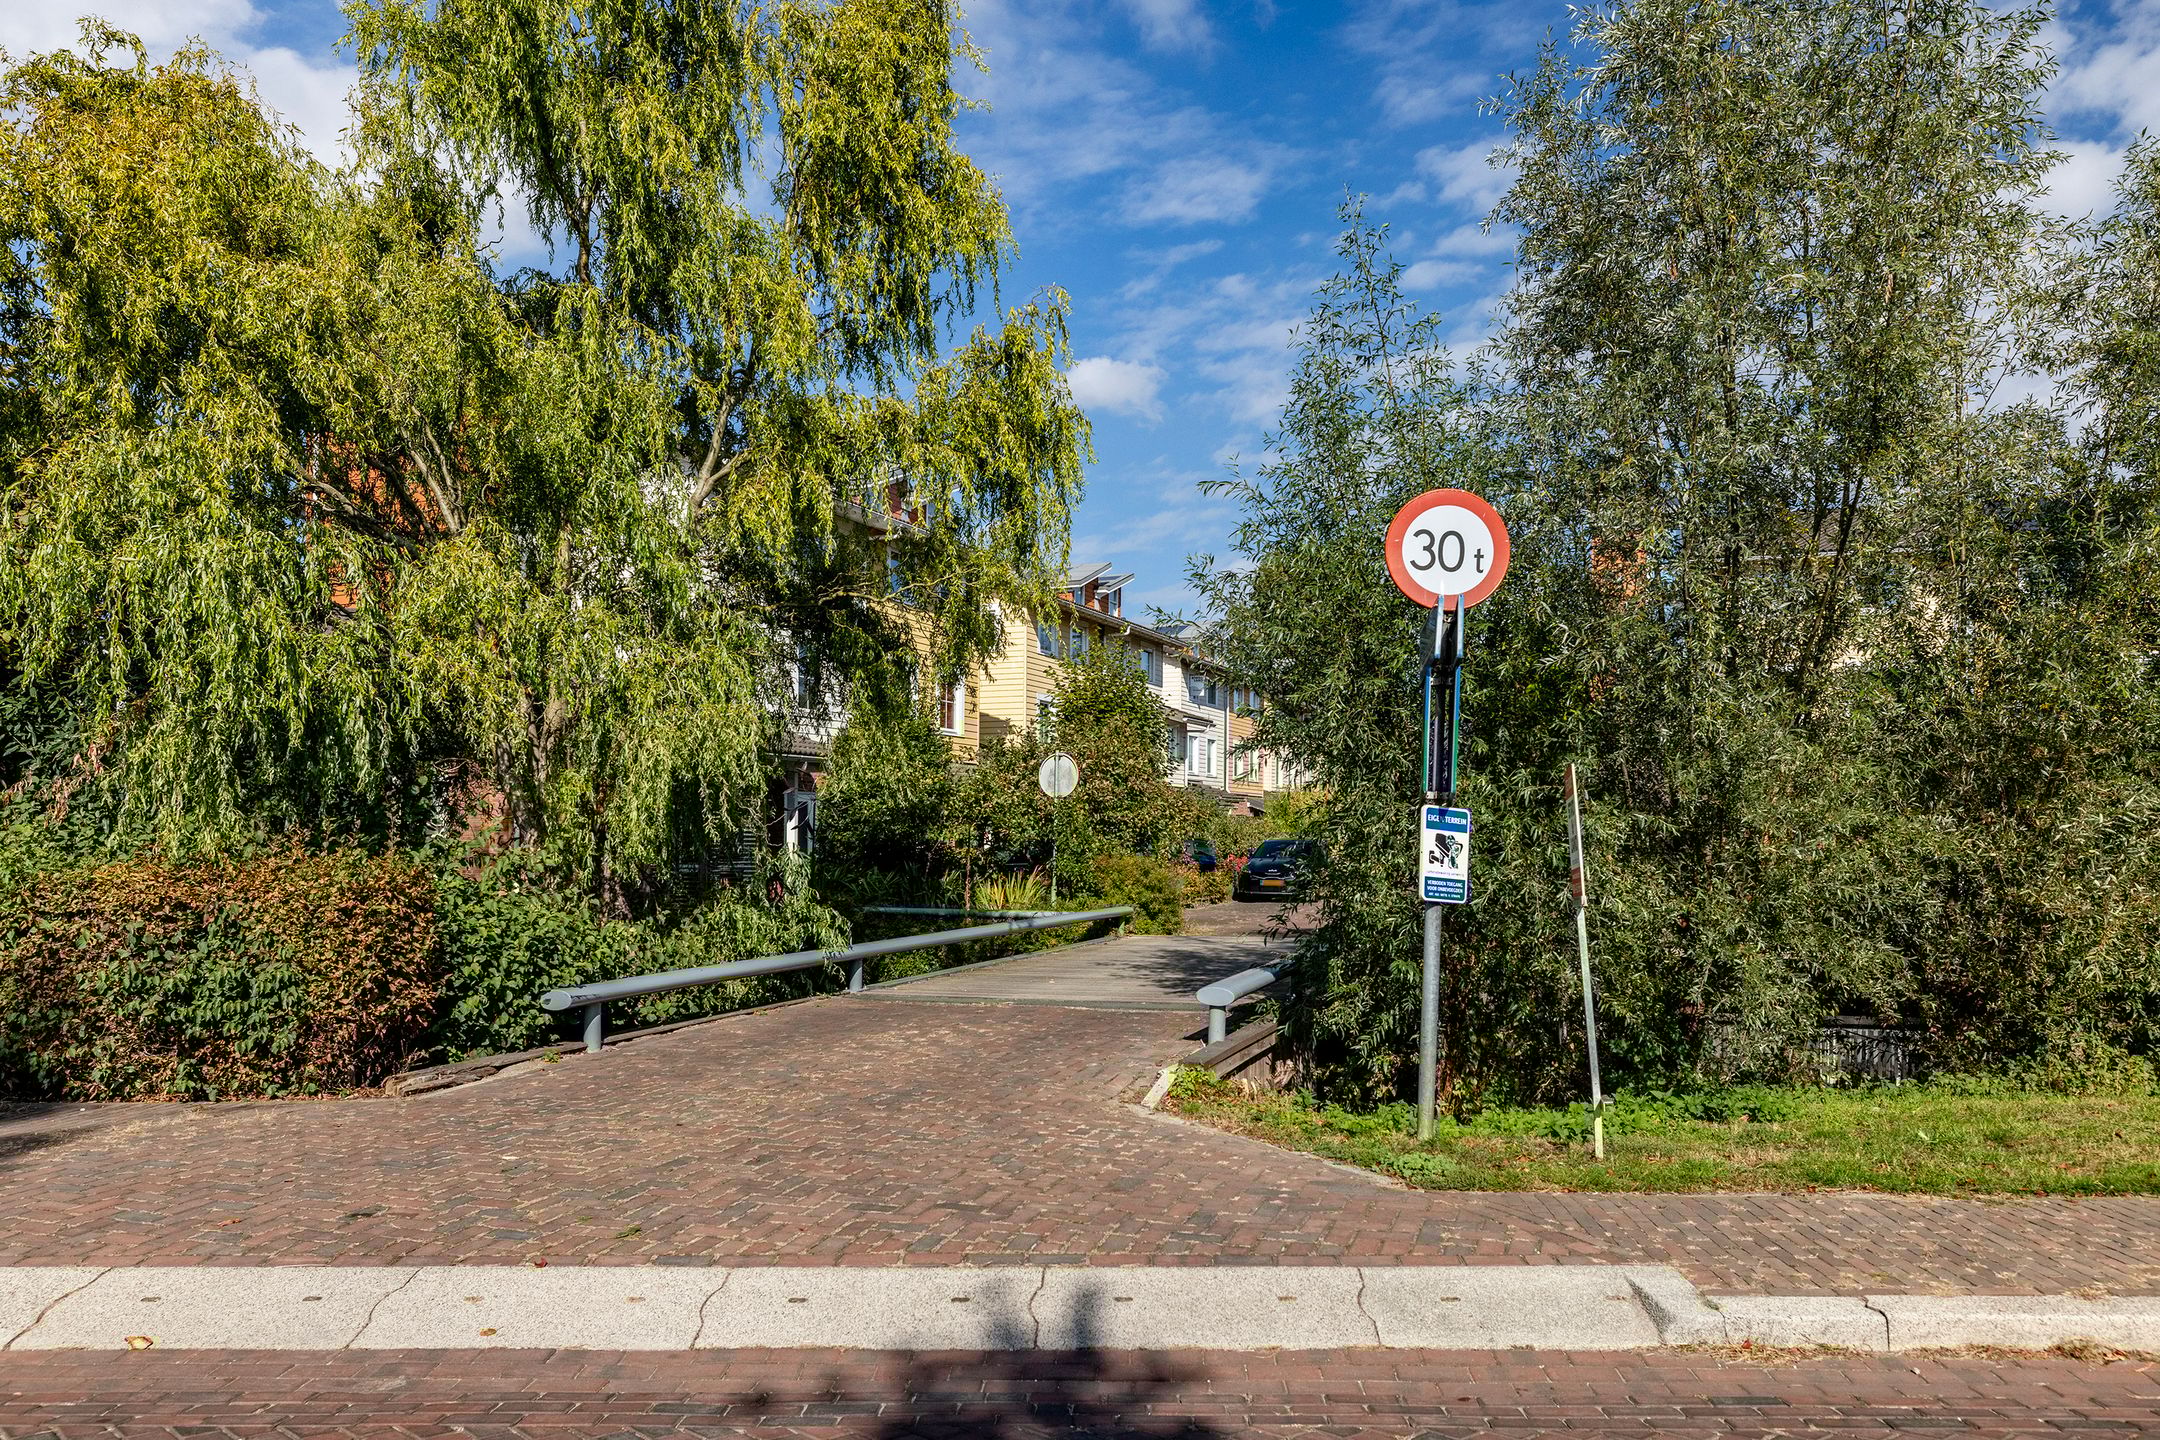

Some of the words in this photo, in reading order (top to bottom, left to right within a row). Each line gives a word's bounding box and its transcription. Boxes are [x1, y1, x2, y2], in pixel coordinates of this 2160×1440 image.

[1410, 529, 1465, 573] 30
[1474, 548, 1484, 574] t
[1428, 813, 1444, 823] EIGEN
[1445, 816, 1467, 825] TERREIN
